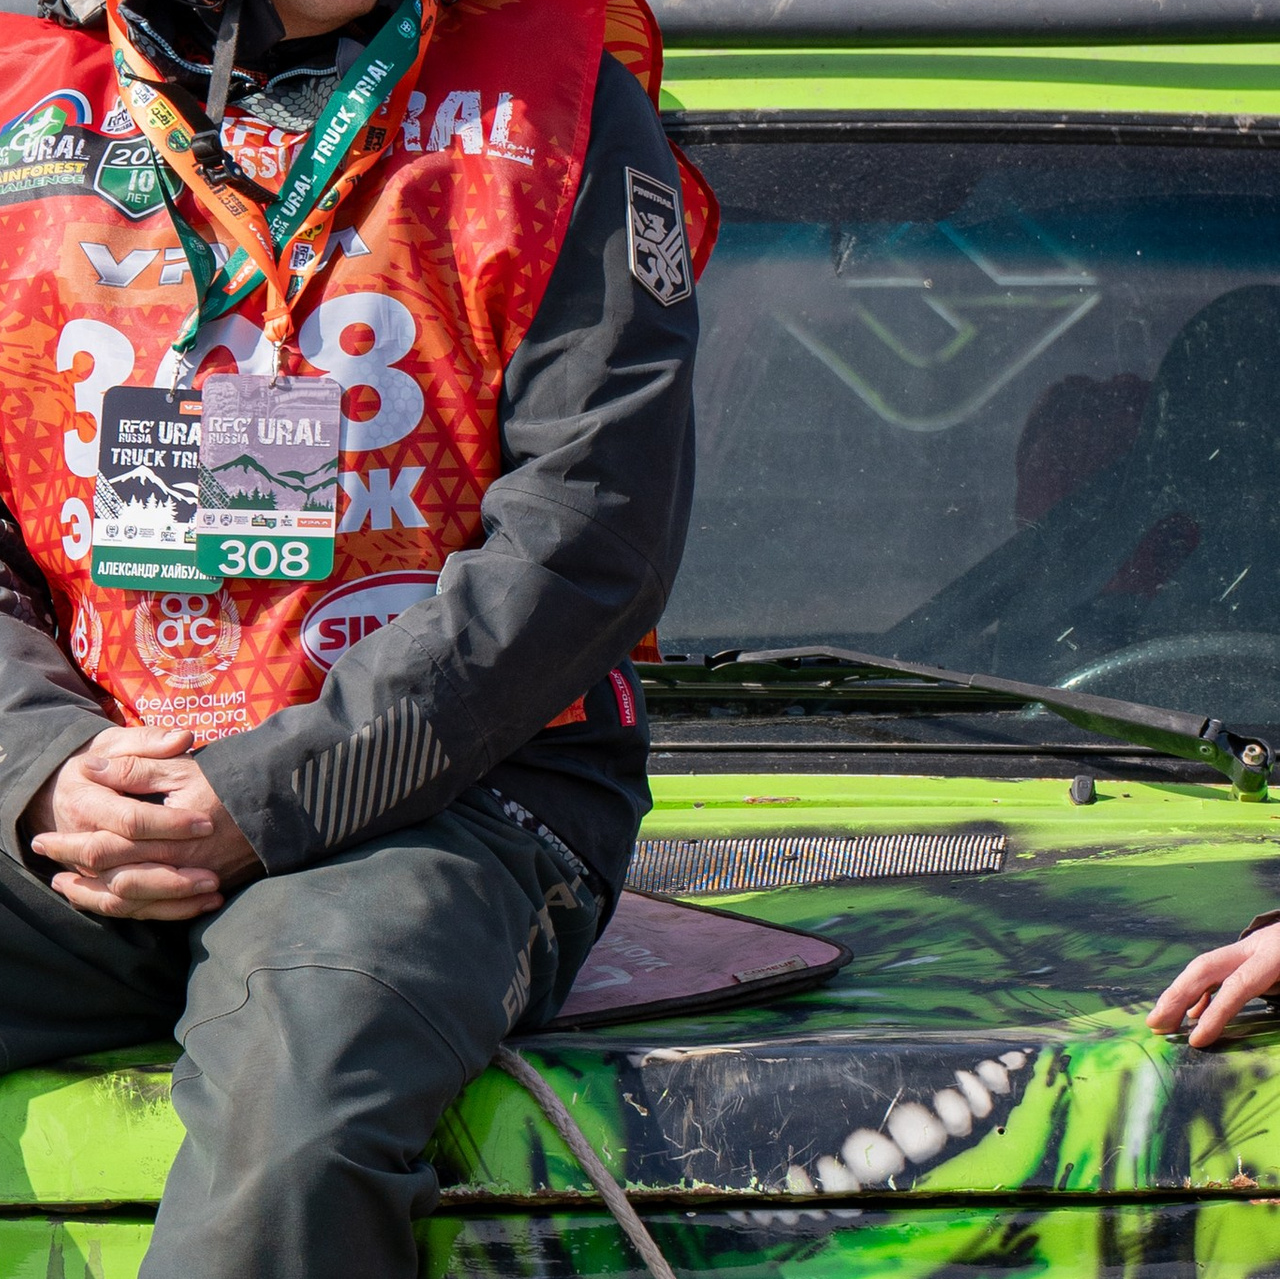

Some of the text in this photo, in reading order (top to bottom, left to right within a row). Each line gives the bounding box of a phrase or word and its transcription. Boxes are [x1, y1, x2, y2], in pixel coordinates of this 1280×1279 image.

[281, 173, 318, 217] URAL
[311, 104, 356, 167] TRUCK
[348, 59, 395, 105] TRIAL
[402, 89, 535, 166] RAL
[23, 134, 91, 163] URAL
[128, 169, 155, 193] 10
[125, 193, 150, 204] ЛЕТ
[118, 432, 152, 444] RUSSIA
[158, 421, 201, 446] URA
[208, 433, 249, 446] RUSSIA
[258, 417, 330, 447] URAL
[111, 447, 200, 469] TRUCK TRI
[218, 539, 310, 577] 308
[97, 561, 217, 580] АЛЕКСАНДР ХАЙБУЛ
[135, 690, 246, 713] федерация
